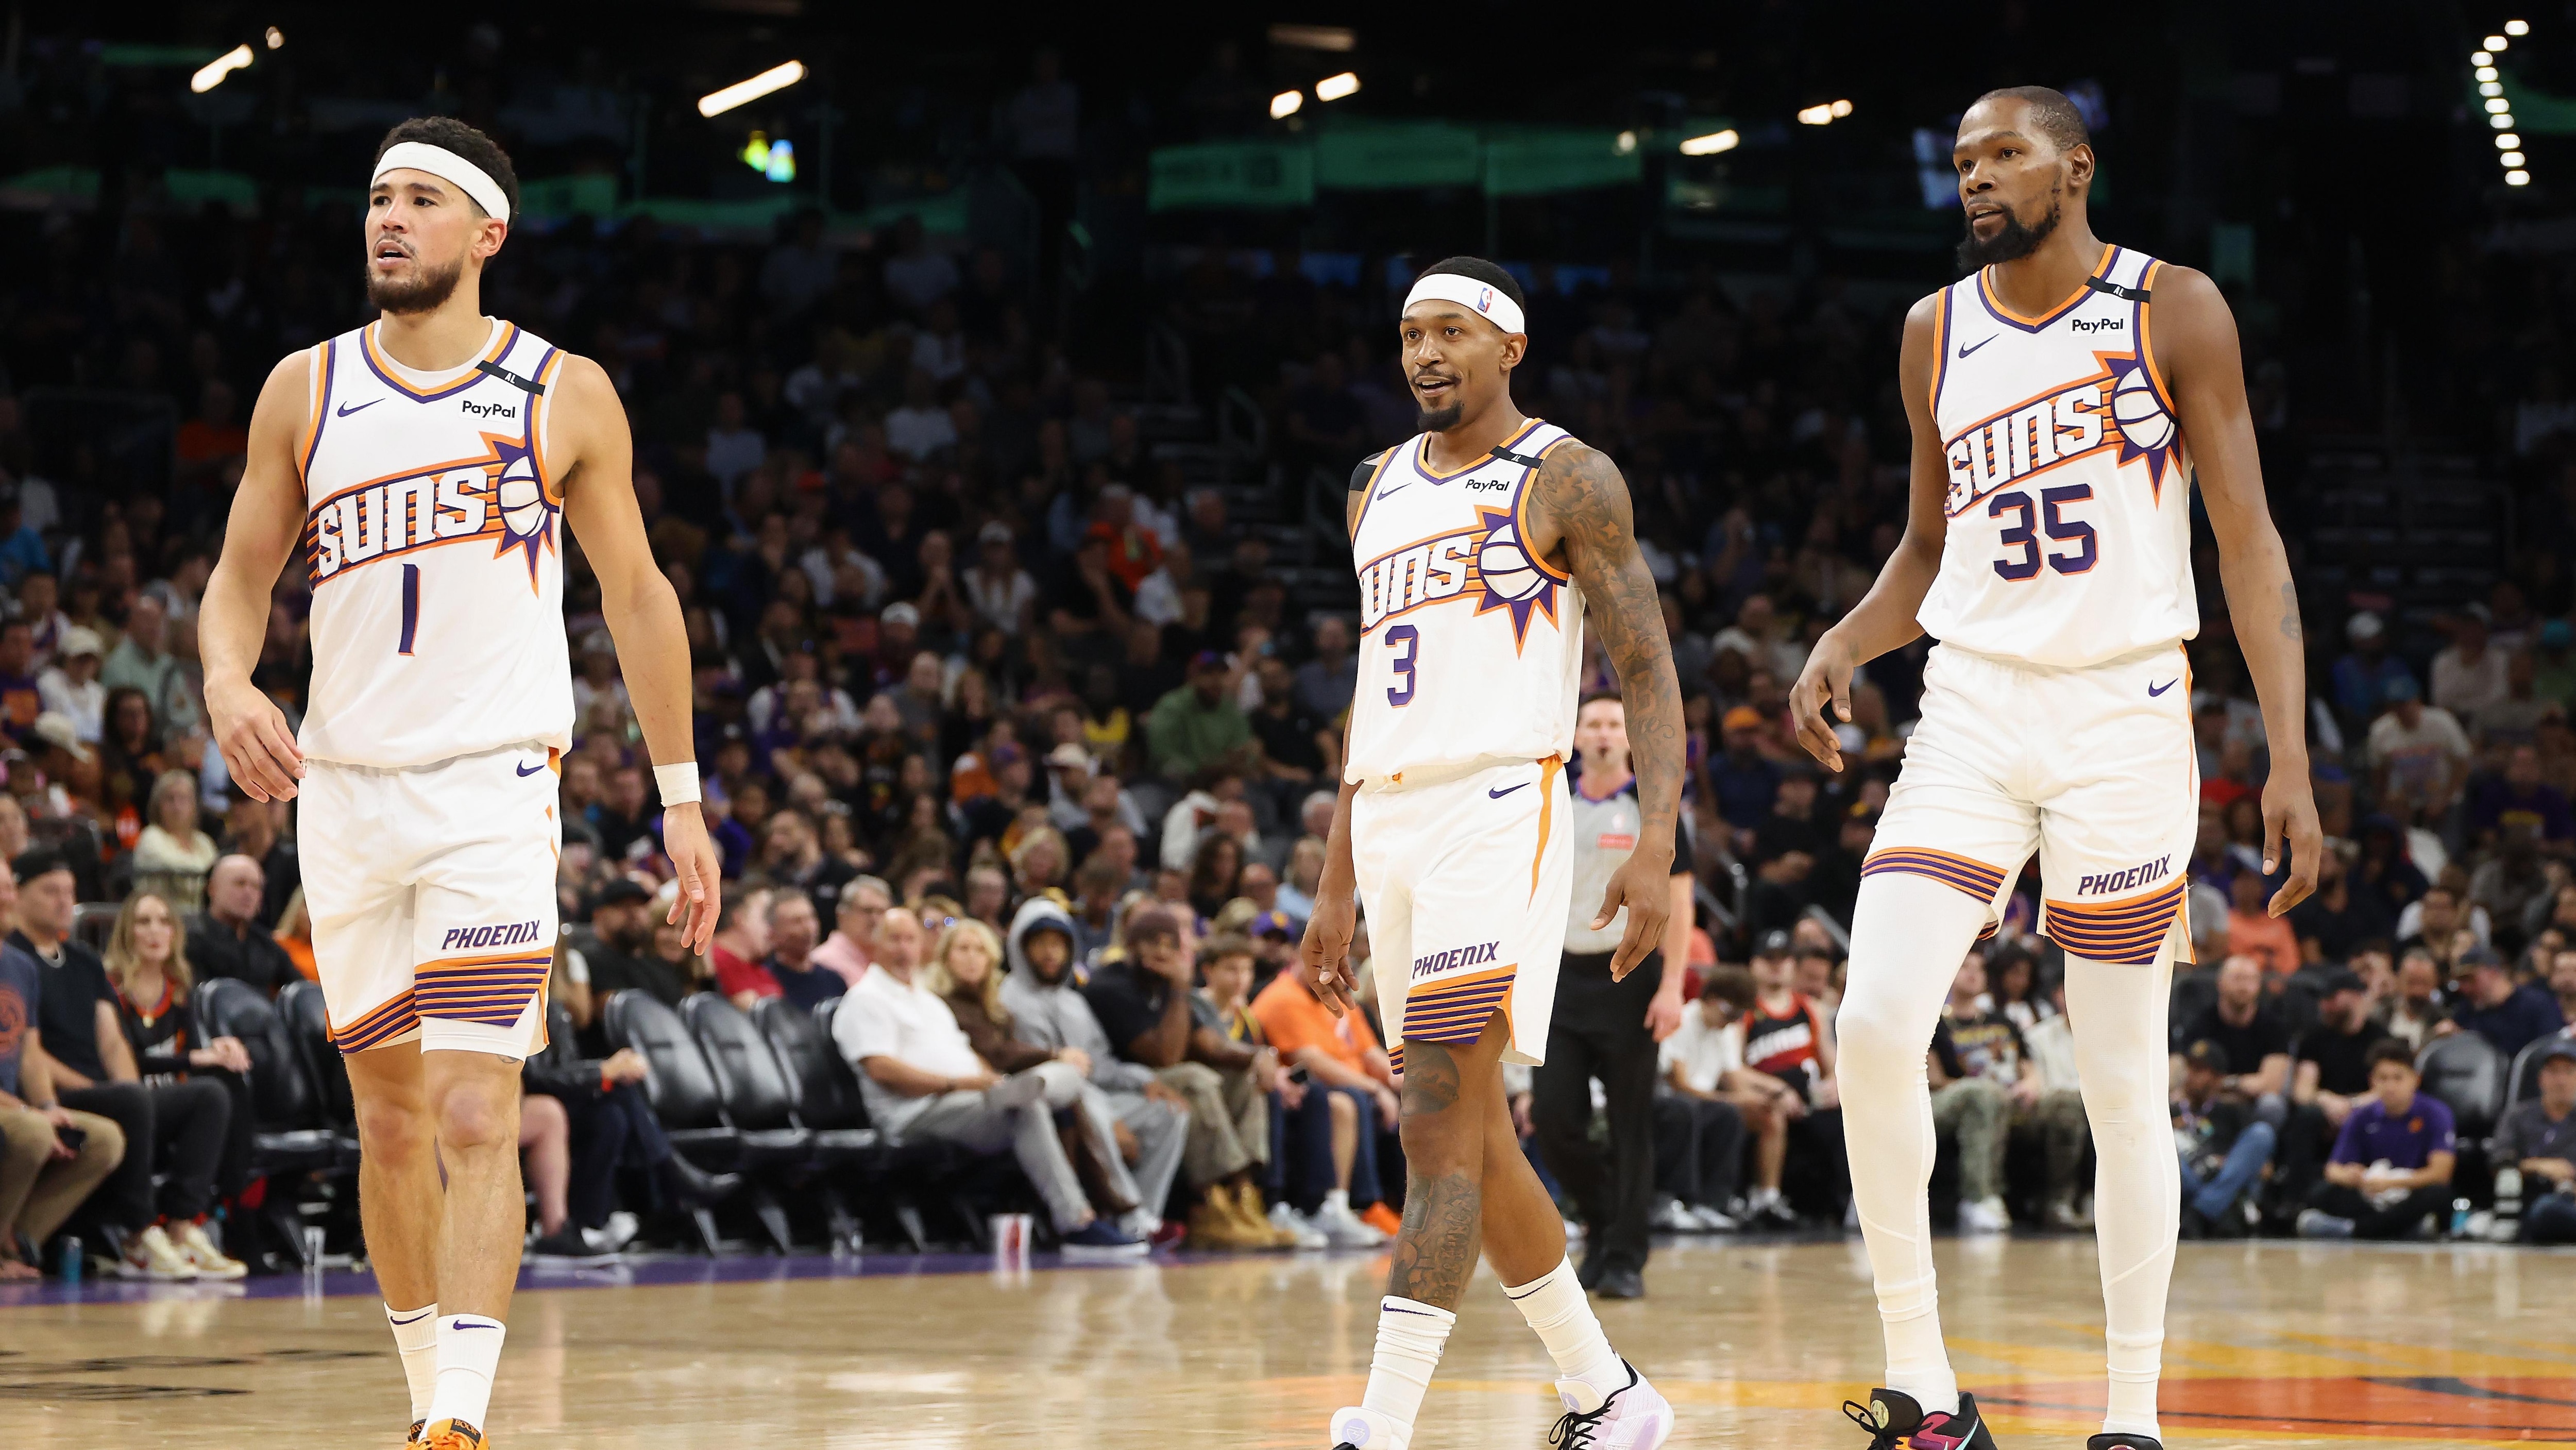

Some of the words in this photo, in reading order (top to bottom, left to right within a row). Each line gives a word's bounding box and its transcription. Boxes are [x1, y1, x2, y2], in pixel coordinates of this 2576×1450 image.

[2113, 285, 2124, 297] AL
[2072, 318, 2124, 334] PayPal
[504, 372, 516, 384] AL
[462, 400, 515, 418] PayPal
[1465, 479, 1510, 492] PayPal
[1988, 483, 2099, 582] 35
[1360, 534, 1473, 628] UNS
[398, 564, 421, 656] 1
[1384, 624, 1420, 709] 3
[2077, 853, 2171, 896] PHOENIX
[441, 919, 540, 950] PHOENIX
[1412, 941, 1500, 980] PHOENIX
[454, 1419, 480, 1436] BOOK
